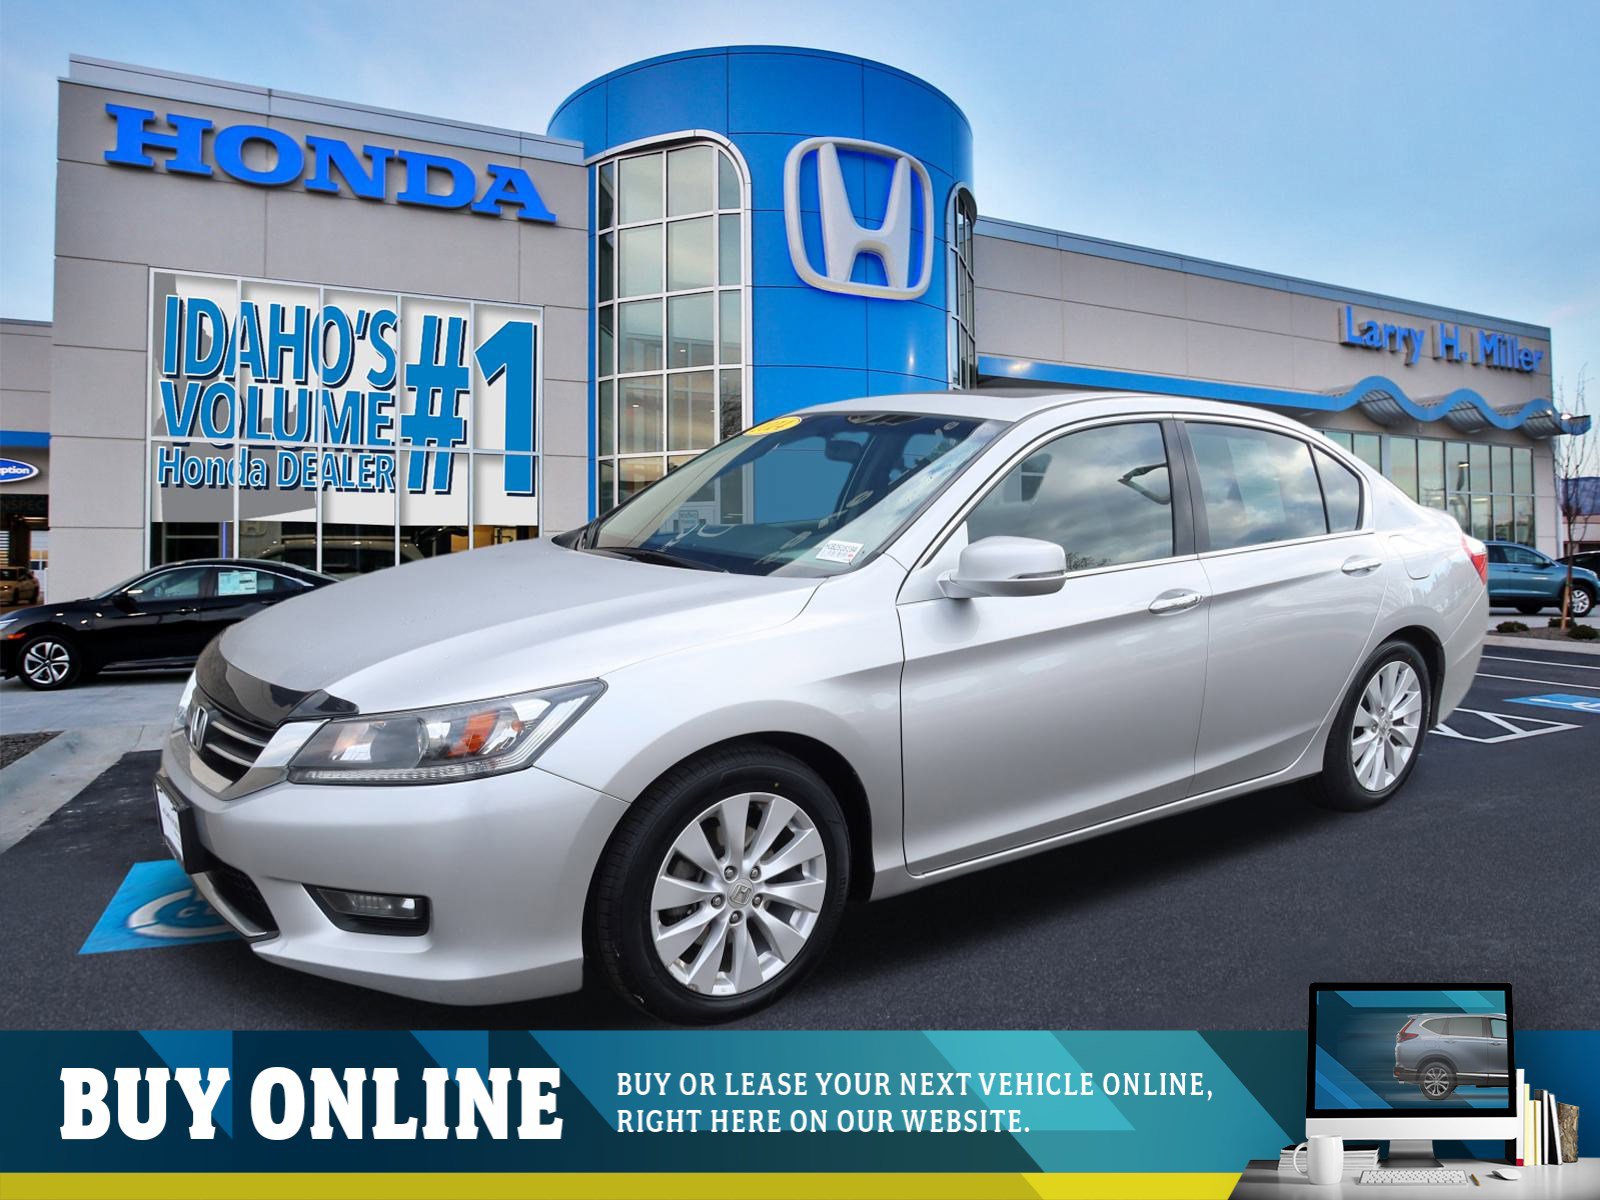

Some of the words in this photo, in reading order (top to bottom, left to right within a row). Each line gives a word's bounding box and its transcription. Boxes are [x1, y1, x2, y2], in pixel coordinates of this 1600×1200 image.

[104, 103, 557, 223] HONDA
[161, 295, 399, 389] IDAHO'S
[1343, 305, 1424, 365] Larry
[1438, 322, 1469, 363] H.
[1477, 329, 1545, 374] Miller
[159, 380, 397, 450] VOLUME
[0, 466, 30, 476] ption
[158, 446, 267, 489] Honda
[276, 450, 397, 493] DEALER
